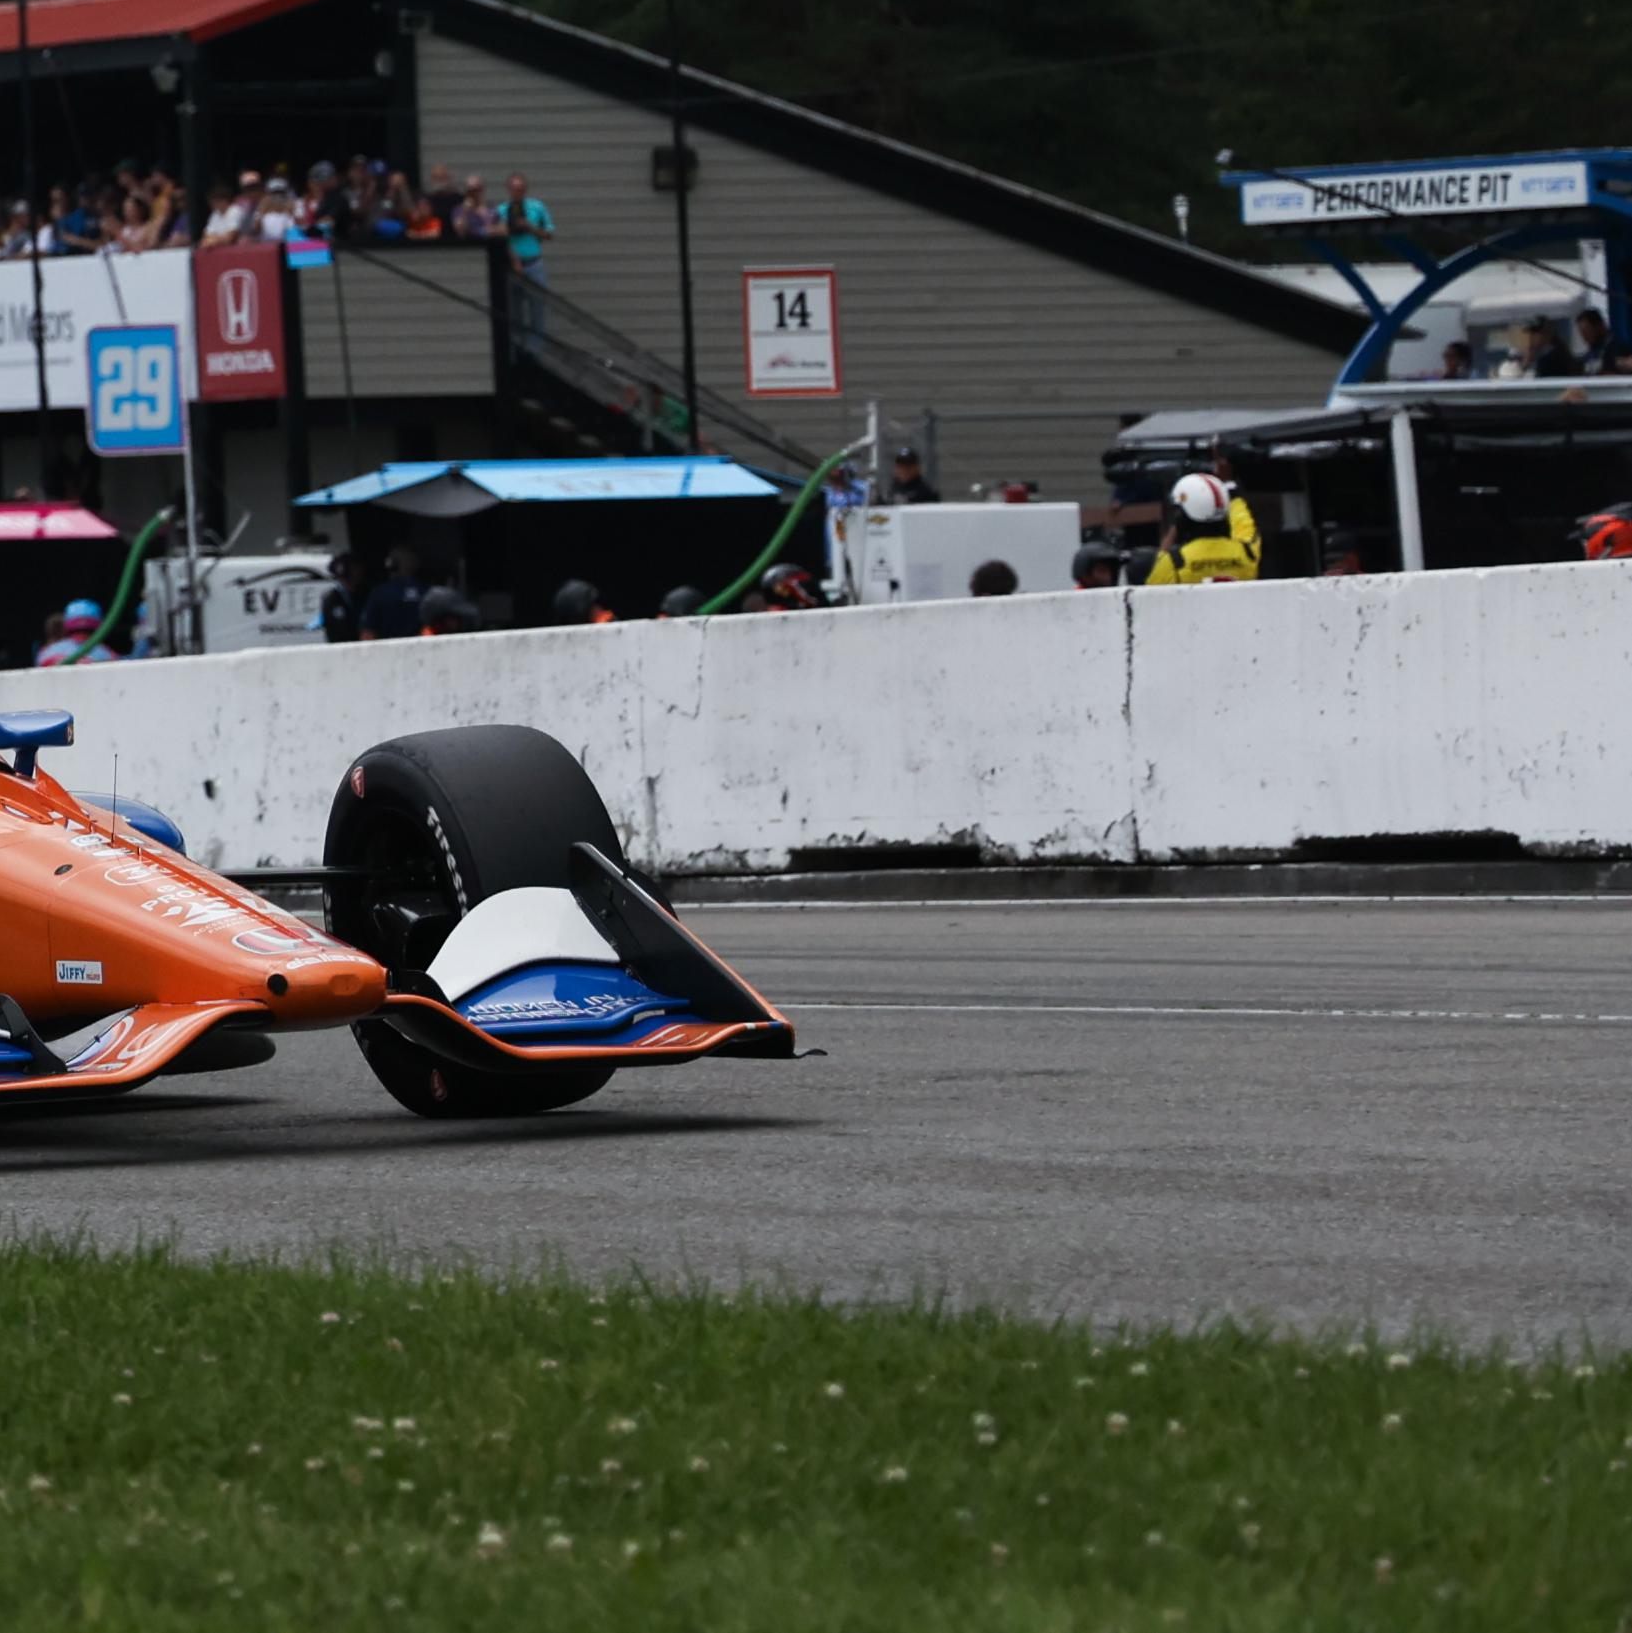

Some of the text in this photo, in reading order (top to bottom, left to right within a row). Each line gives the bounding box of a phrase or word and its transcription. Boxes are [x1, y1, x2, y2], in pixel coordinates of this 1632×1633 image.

[1312, 174, 1512, 212] PERFORMANCE PIT
[8, 302, 75, 344] Moors
[773, 289, 813, 329] 14
[97, 345, 173, 431] 29
[59, 963, 86, 980] JIFFY
[468, 994, 615, 1015] WOMEN IN
